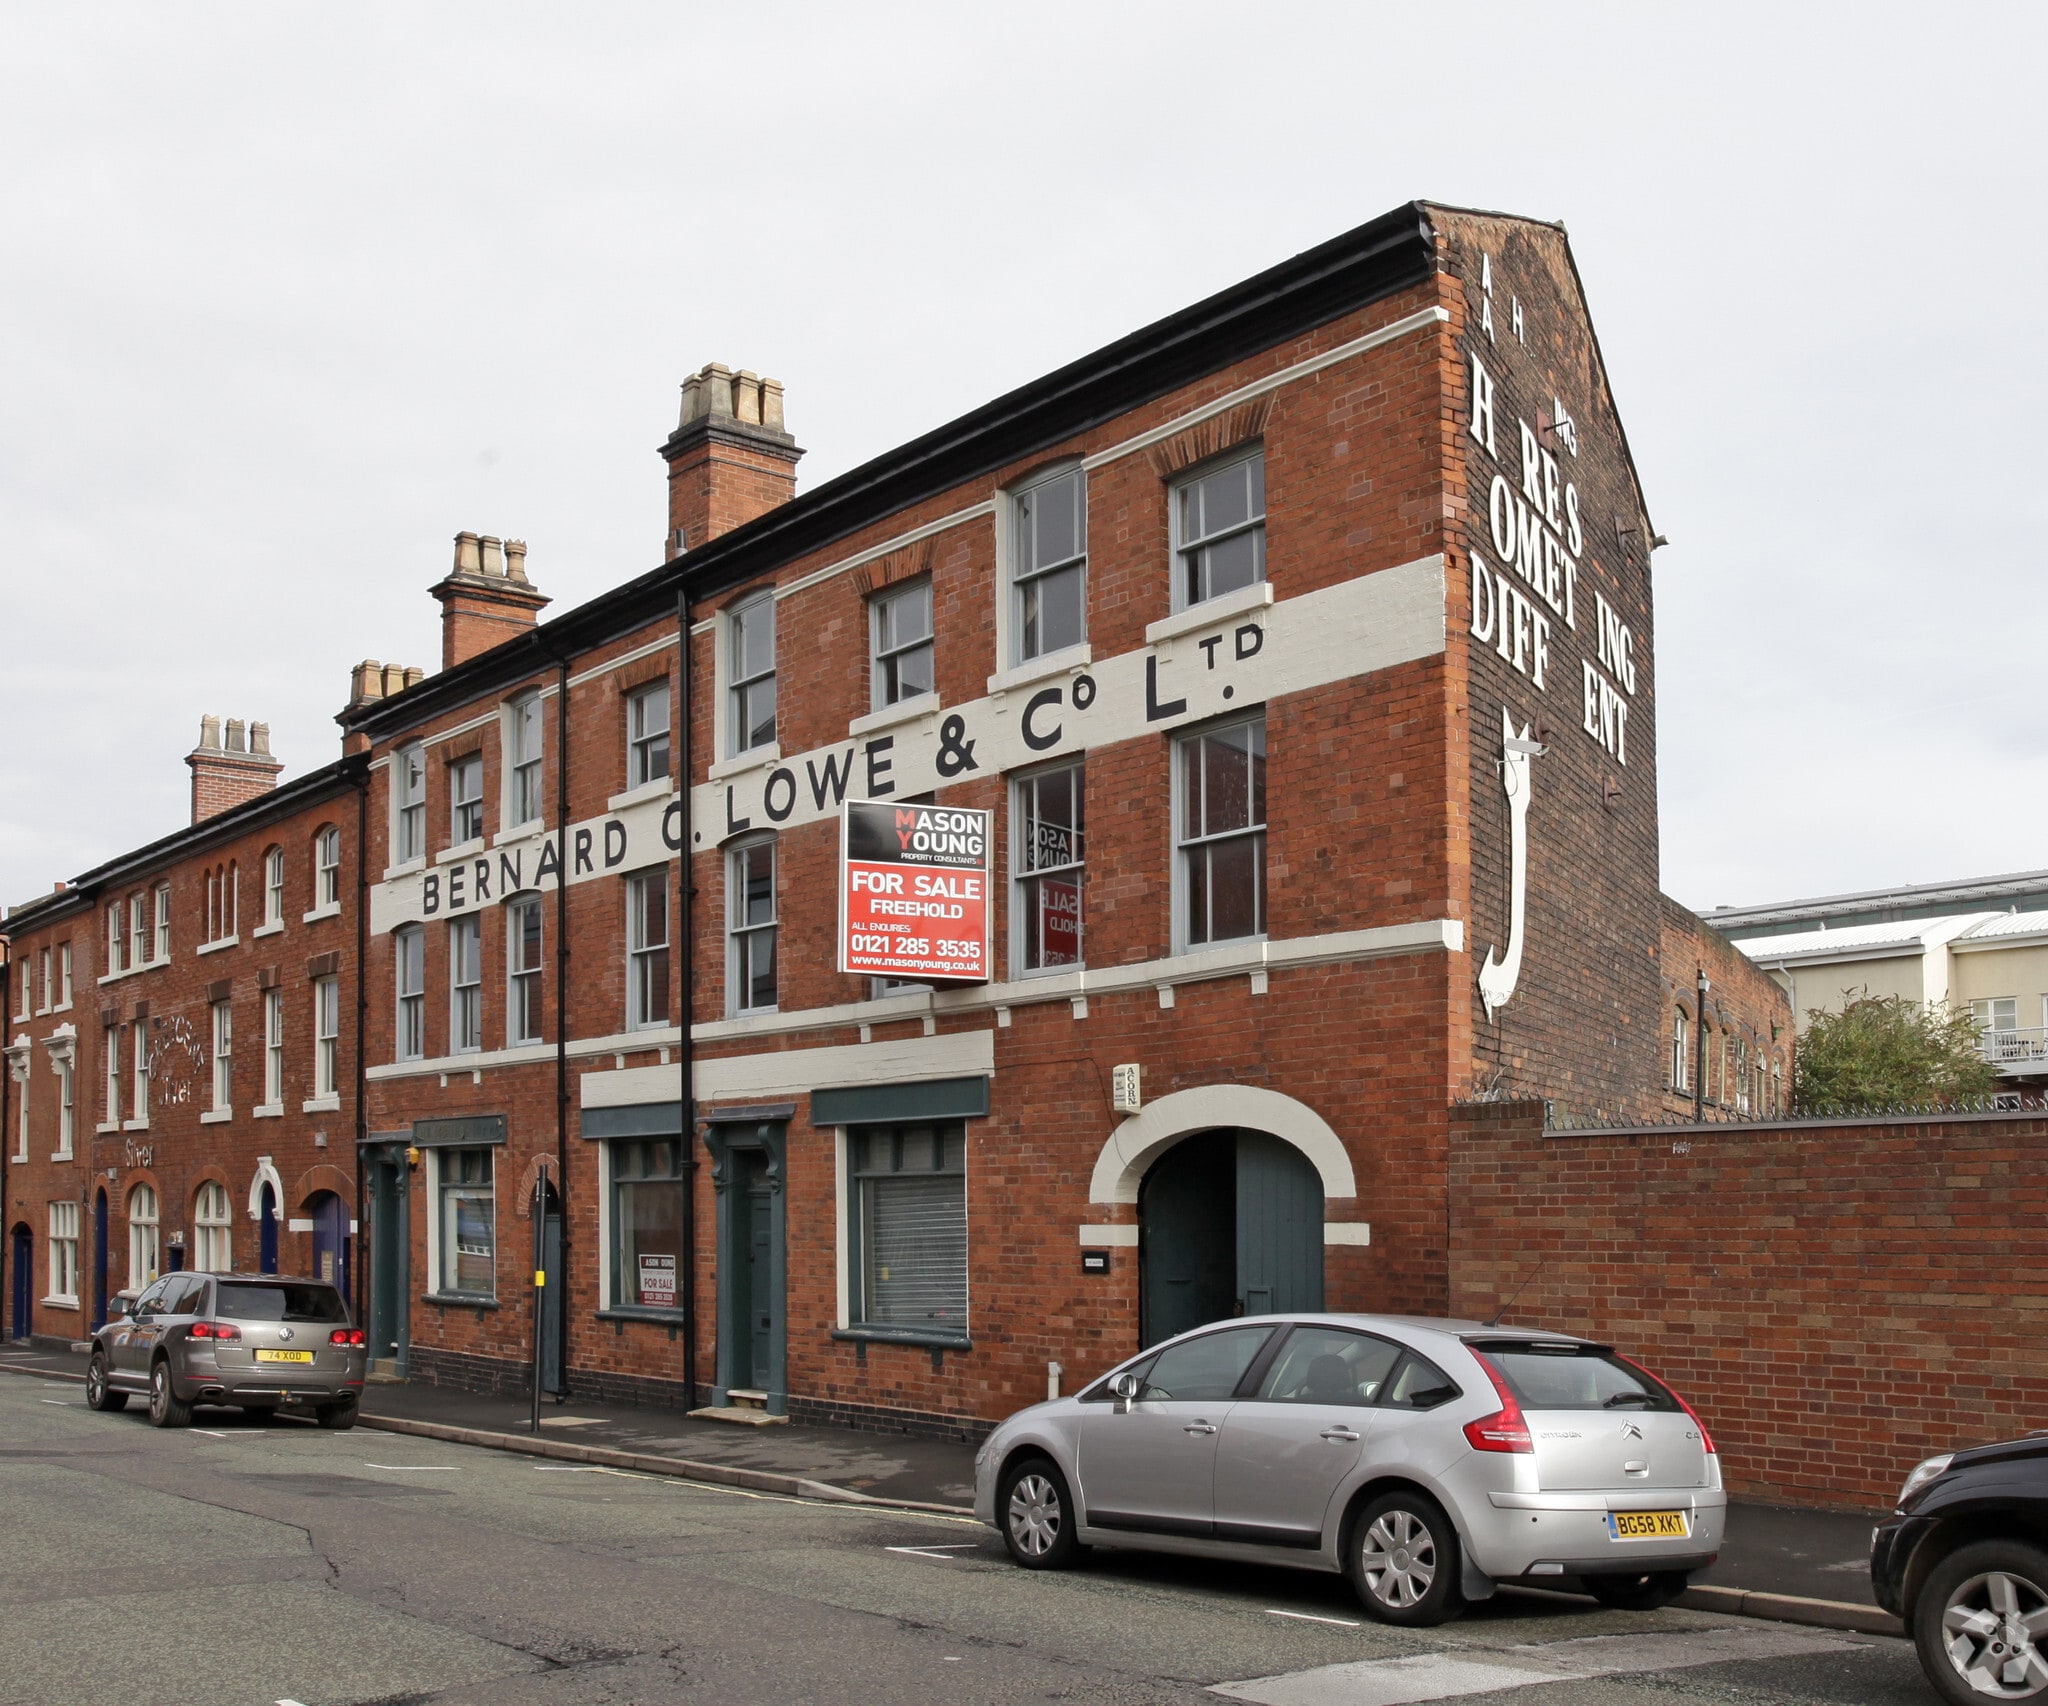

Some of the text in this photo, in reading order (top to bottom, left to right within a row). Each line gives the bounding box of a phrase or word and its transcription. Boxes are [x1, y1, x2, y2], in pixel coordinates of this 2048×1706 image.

[1554, 396, 1577, 458] ING
[1489, 475, 1636, 696] OMET ING
[1470, 550, 1628, 767] DIFF ENT
[424, 819, 627, 915] BERNARD
[726, 735, 895, 836] LOWE
[935, 714, 979, 777] &
[896, 809, 983, 835] MASON
[896, 830, 983, 855] YOUNG
[901, 852, 977, 865] PROPERTY CONSULTANTS
[852, 871, 981, 900] FOR SALE
[870, 899, 963, 919] FREEHOLD
[852, 922, 868, 931] ALL
[852, 934, 981, 958] 0121 285 3535
[852, 956, 981, 971] www.masonyoung.co.uk
[1127, 1066, 1137, 1105] ACORN
[644, 1278, 673, 1290] FOR SALE
[1617, 1514, 1682, 1534] BG58 XKT
